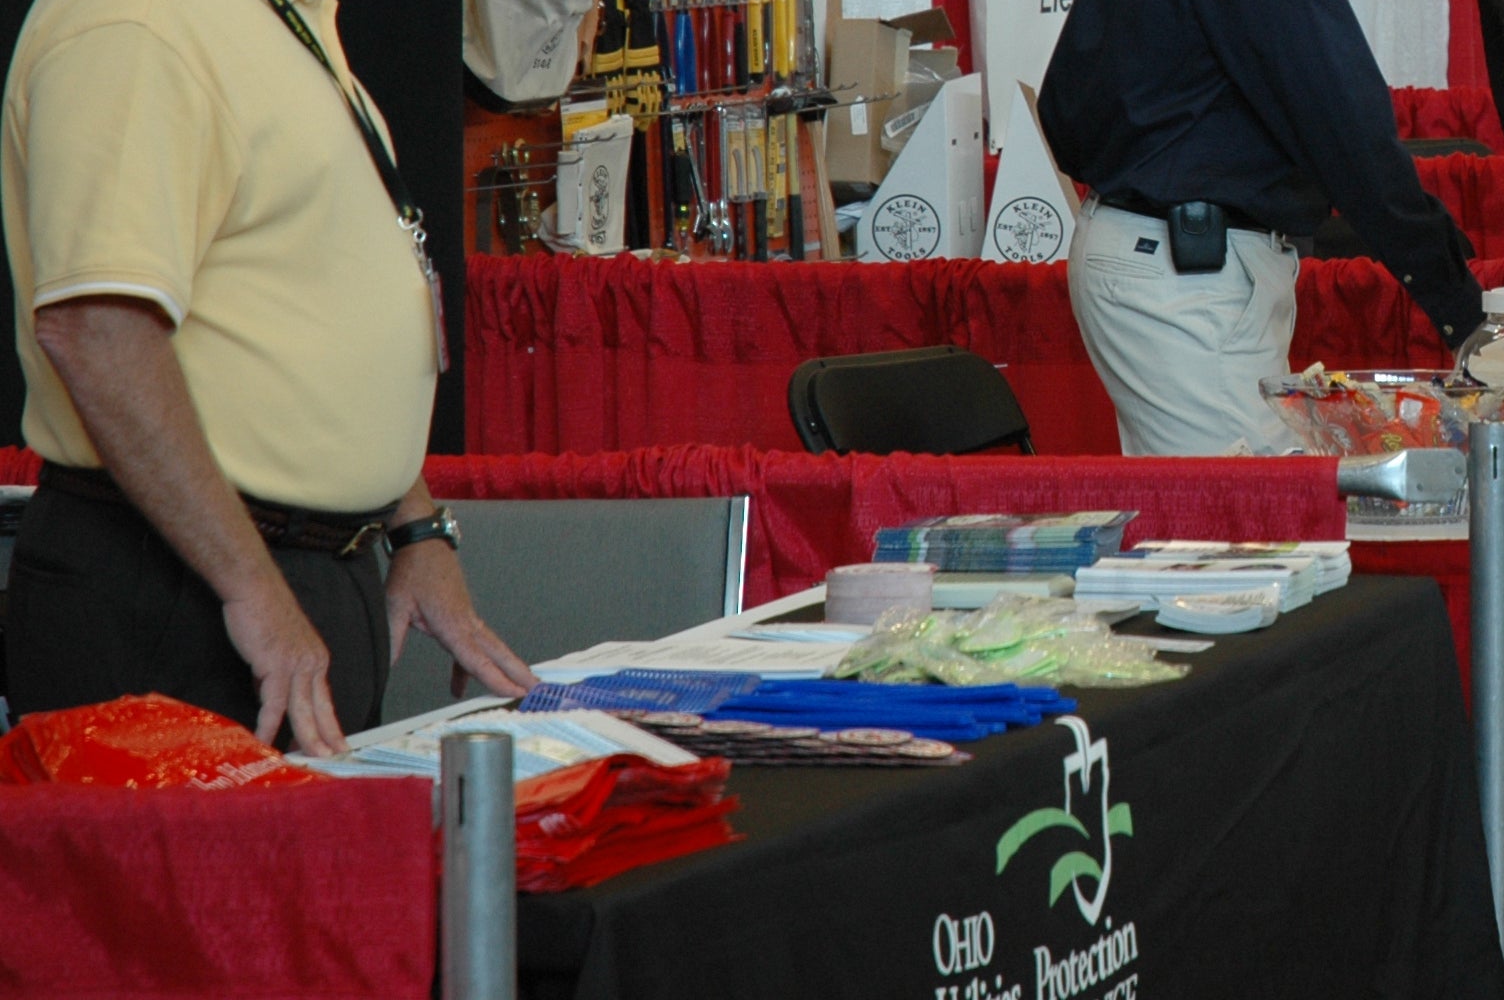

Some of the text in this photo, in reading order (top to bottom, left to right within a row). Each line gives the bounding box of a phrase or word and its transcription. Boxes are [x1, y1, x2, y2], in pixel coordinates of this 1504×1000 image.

[886, 200, 927, 213] KLEIN
[1013, 202, 1053, 219] KLEIN
[887, 246, 926, 260] TOOLS
[932, 911, 995, 976] OHIO
[1034, 915, 1139, 1000] Protection
